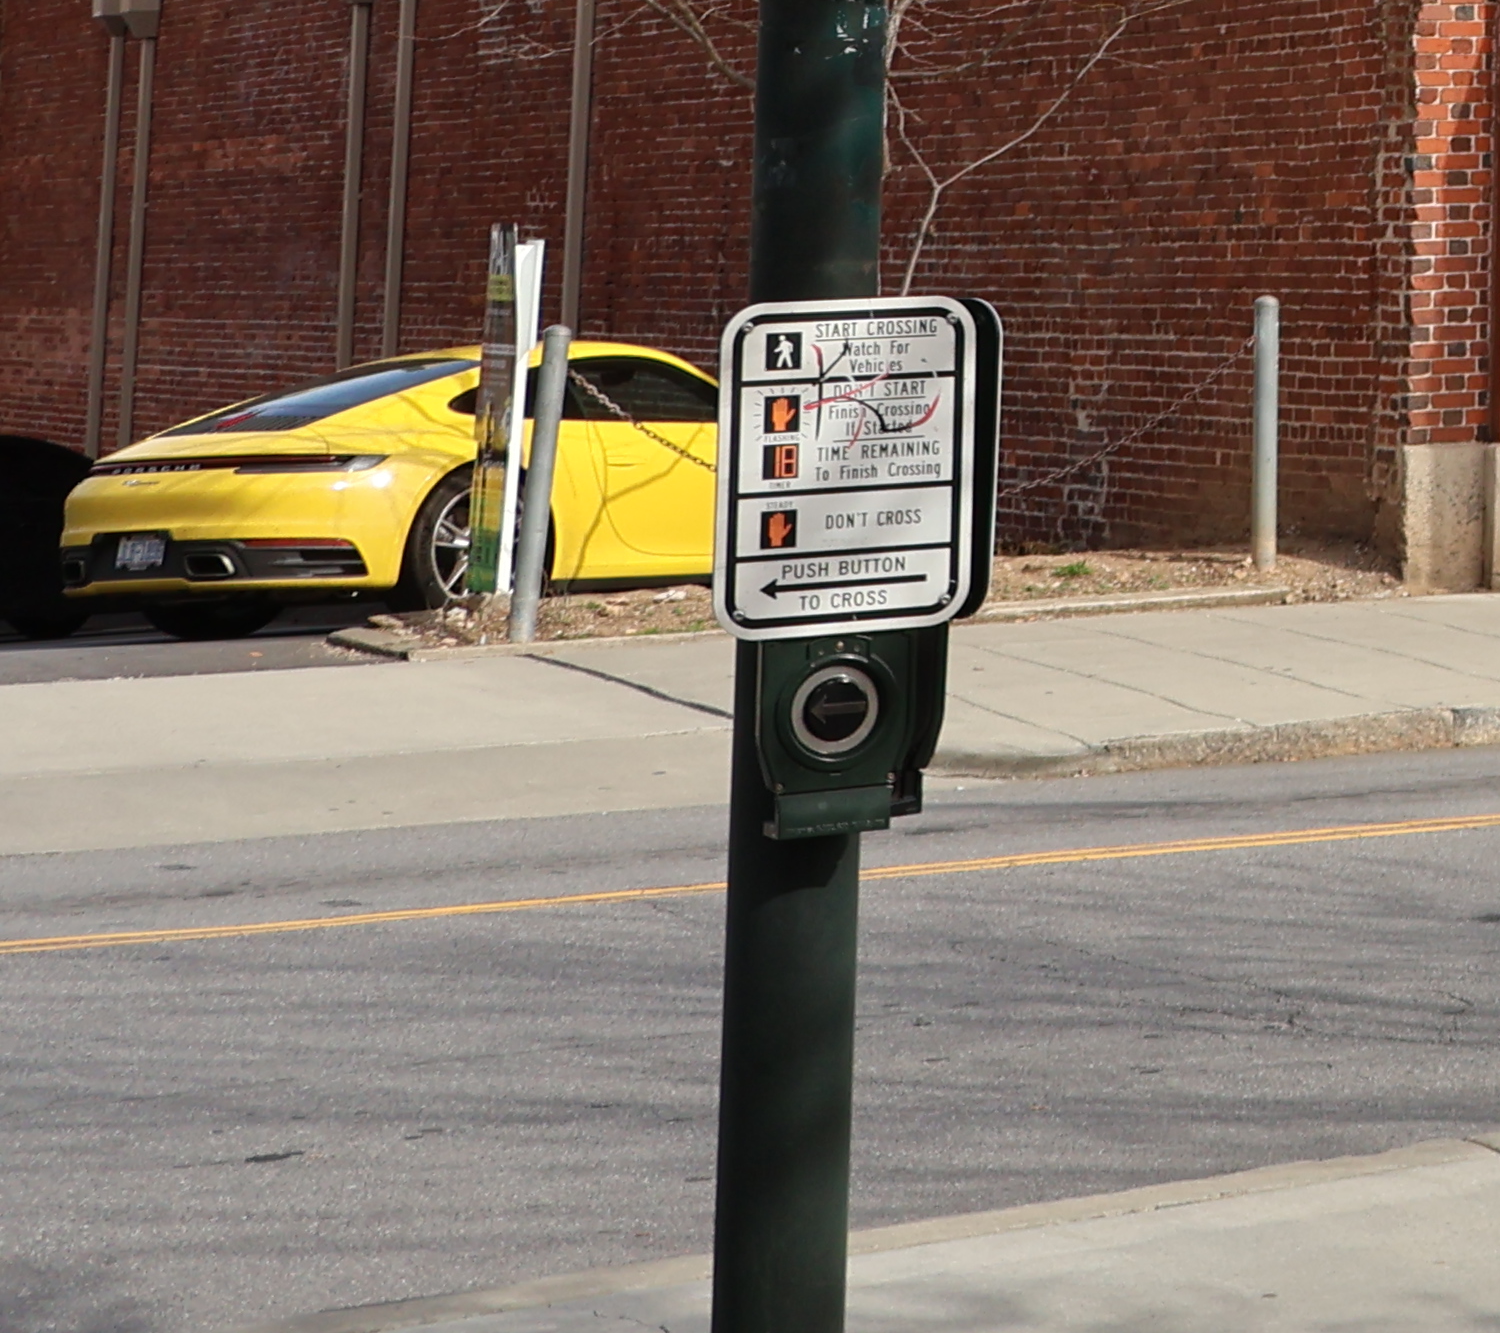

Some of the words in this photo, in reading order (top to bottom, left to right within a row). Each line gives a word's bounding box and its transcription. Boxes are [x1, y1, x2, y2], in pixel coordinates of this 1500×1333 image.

[815, 322, 857, 338] START
[867, 319, 938, 336] CROSSING
[842, 342, 883, 357] Watch
[890, 341, 910, 355] For
[850, 358, 903, 374] Vehices
[884, 380, 926, 396] START
[764, 434, 800, 443] FLASHING
[818, 446, 849, 462] TIME
[861, 440, 941, 459] REMAINING
[112, 463, 202, 475] PORSCHE
[815, 467, 830, 482] To
[840, 464, 878, 480] Finish
[888, 461, 941, 480] Crossing
[769, 481, 791, 489] TIMER
[766, 501, 793, 509] STEADY
[825, 512, 868, 530] DON'T
[877, 509, 922, 526] CROSS
[782, 562, 829, 580] PUSH
[839, 556, 906, 576] BUTTON
[800, 595, 821, 611] TO
[830, 589, 888, 609] CROSS
